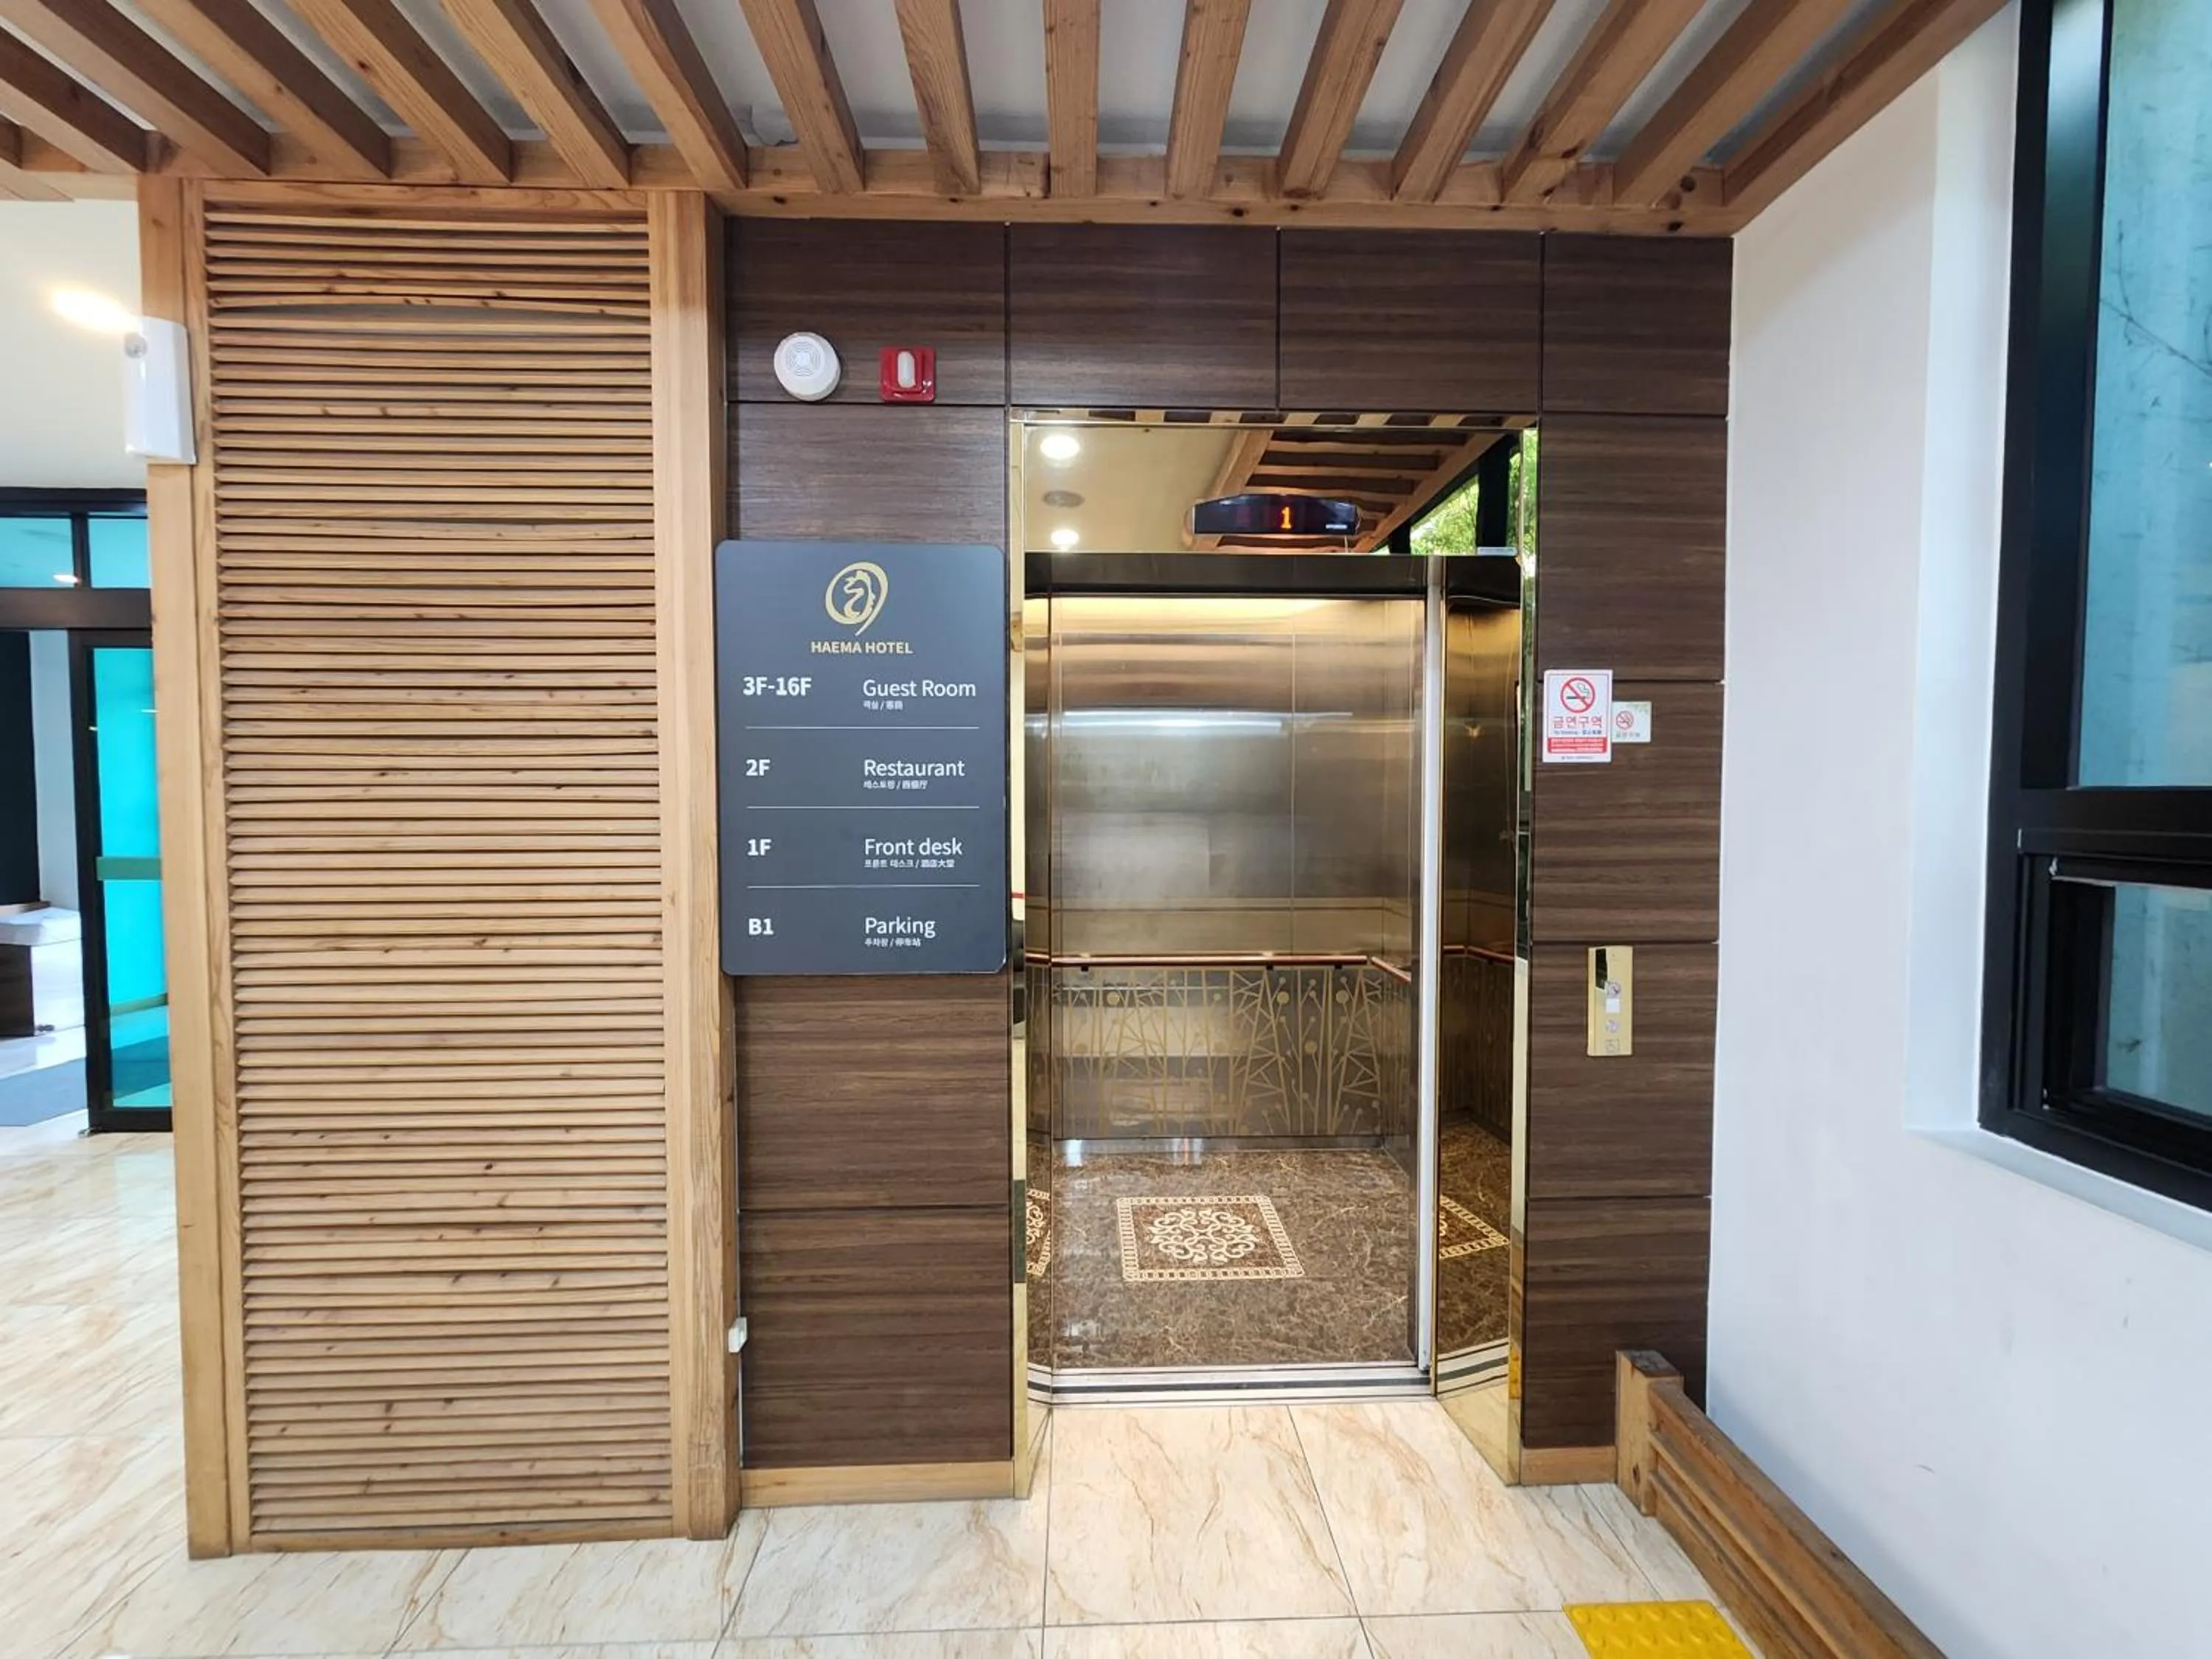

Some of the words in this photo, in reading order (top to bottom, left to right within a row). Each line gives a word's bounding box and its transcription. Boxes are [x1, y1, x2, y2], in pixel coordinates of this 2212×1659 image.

[1281, 507, 1292, 529] 1
[811, 641, 862, 653] HAEMA
[865, 641, 914, 654] HOTEL
[742, 676, 812, 696] 3F-16F
[863, 679, 917, 697] Guest
[922, 679, 976, 697] Room
[1554, 715, 1602, 729] 금연구역
[745, 759, 771, 776] 2F
[864, 759, 965, 776] Restaurant
[748, 838, 772, 856] 1F
[865, 838, 915, 856] Front
[919, 837, 962, 856] desk
[748, 918, 774, 936] B1
[865, 916, 936, 938] Parking
